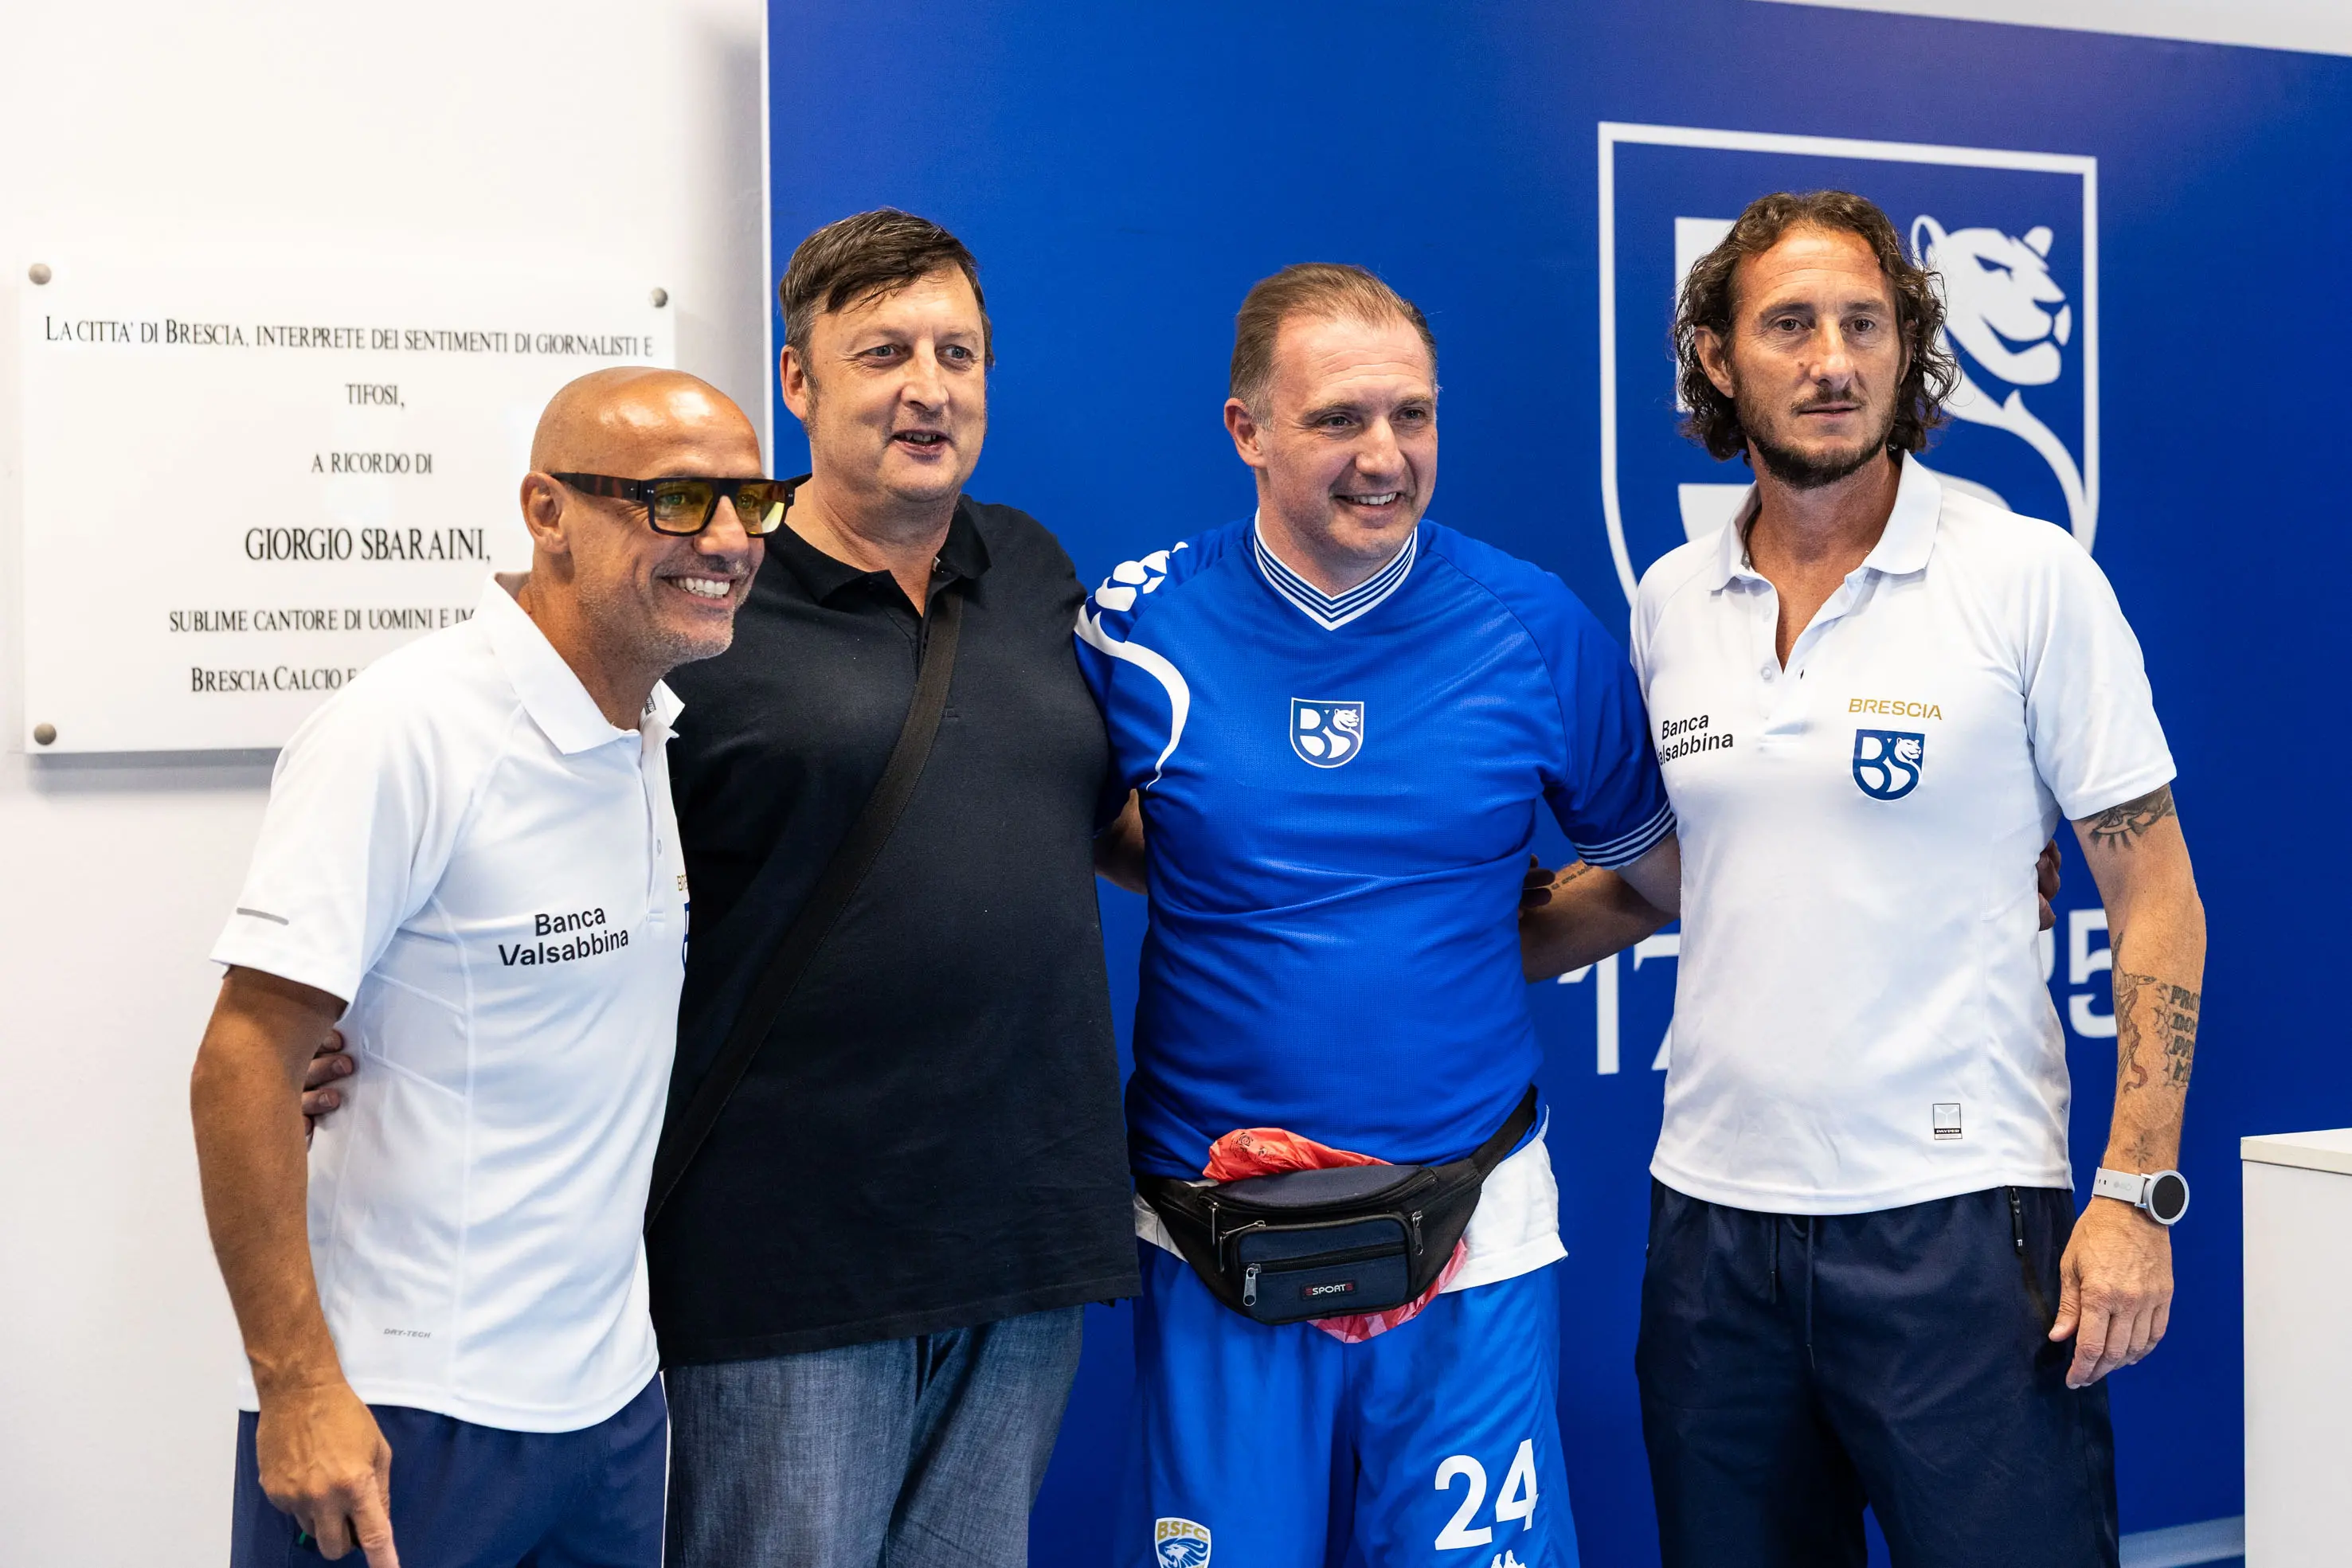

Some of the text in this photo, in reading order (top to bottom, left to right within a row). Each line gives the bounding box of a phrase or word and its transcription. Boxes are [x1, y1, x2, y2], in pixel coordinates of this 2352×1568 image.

[45, 315, 72, 341] LA
[140, 322, 158, 344] DI
[256, 325, 366, 349] INTERPRETE
[371, 328, 399, 350] DEI
[405, 329, 508, 353] SENTIMENTI
[515, 332, 531, 354] DI
[536, 334, 638, 357] GIORNALISTI
[644, 337, 653, 357] E
[344, 383, 405, 410] TIFOSI,
[311, 452, 433, 474] A RICORDO DI
[245, 528, 491, 564] GIORGIO SBARAINI,
[170, 611, 248, 632] SUBLIME
[253, 609, 338, 631] CANTORE
[344, 609, 361, 631] DI
[369, 608, 433, 631] UOMINI
[191, 667, 269, 693] BRESCIA
[273, 666, 342, 691] CALCIO
[1848, 698, 1943, 721] BRESCIA
[1661, 714, 1709, 741] Banca
[1657, 733, 1734, 766] alsabbina
[534, 907, 606, 936] Banca
[498, 929, 629, 966] Valsabbina
[383, 1328, 432, 1339] DRY-TECH
[1434, 1438, 1540, 1550] 24
[1157, 1520, 1208, 1542] BSFC
